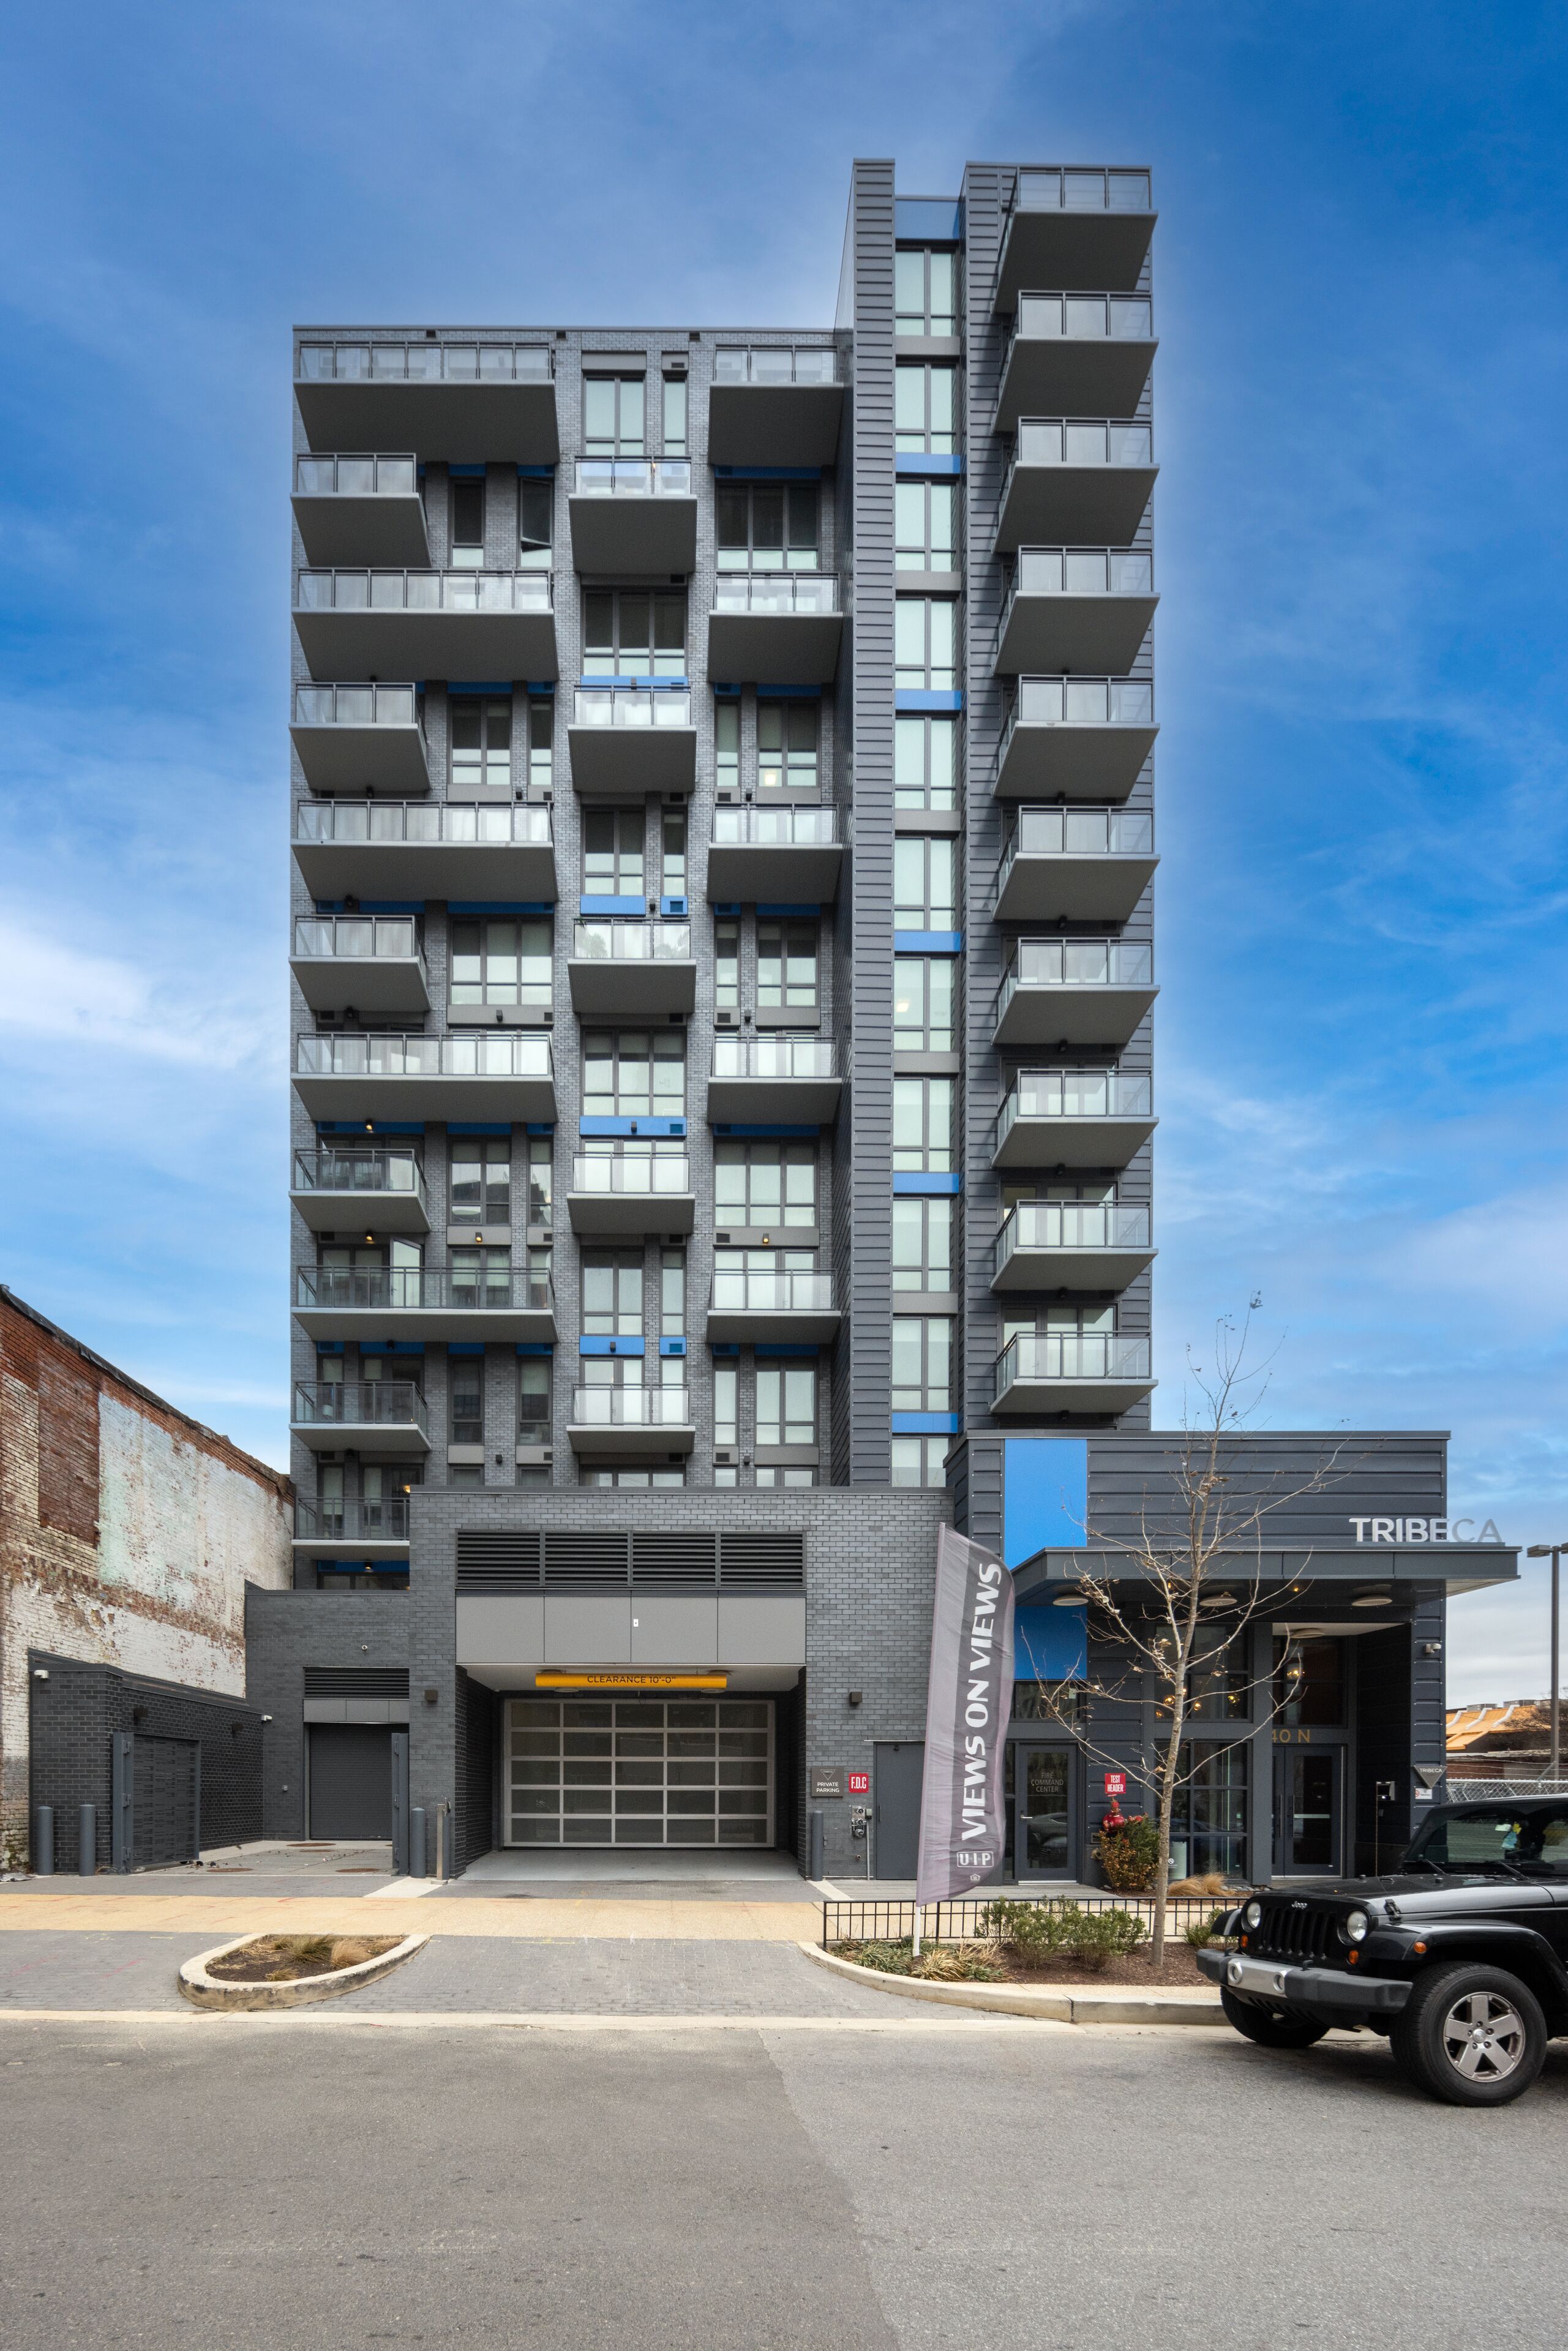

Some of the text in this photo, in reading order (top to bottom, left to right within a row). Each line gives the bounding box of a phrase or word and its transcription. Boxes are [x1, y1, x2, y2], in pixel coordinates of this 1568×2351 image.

[1349, 1518, 1502, 1542] TRIBECA
[961, 1563, 1002, 1840] VIEWS ON VIEWS
[1298, 1730, 1310, 1743] N
[1291, 1900, 1308, 1910] Jeep
